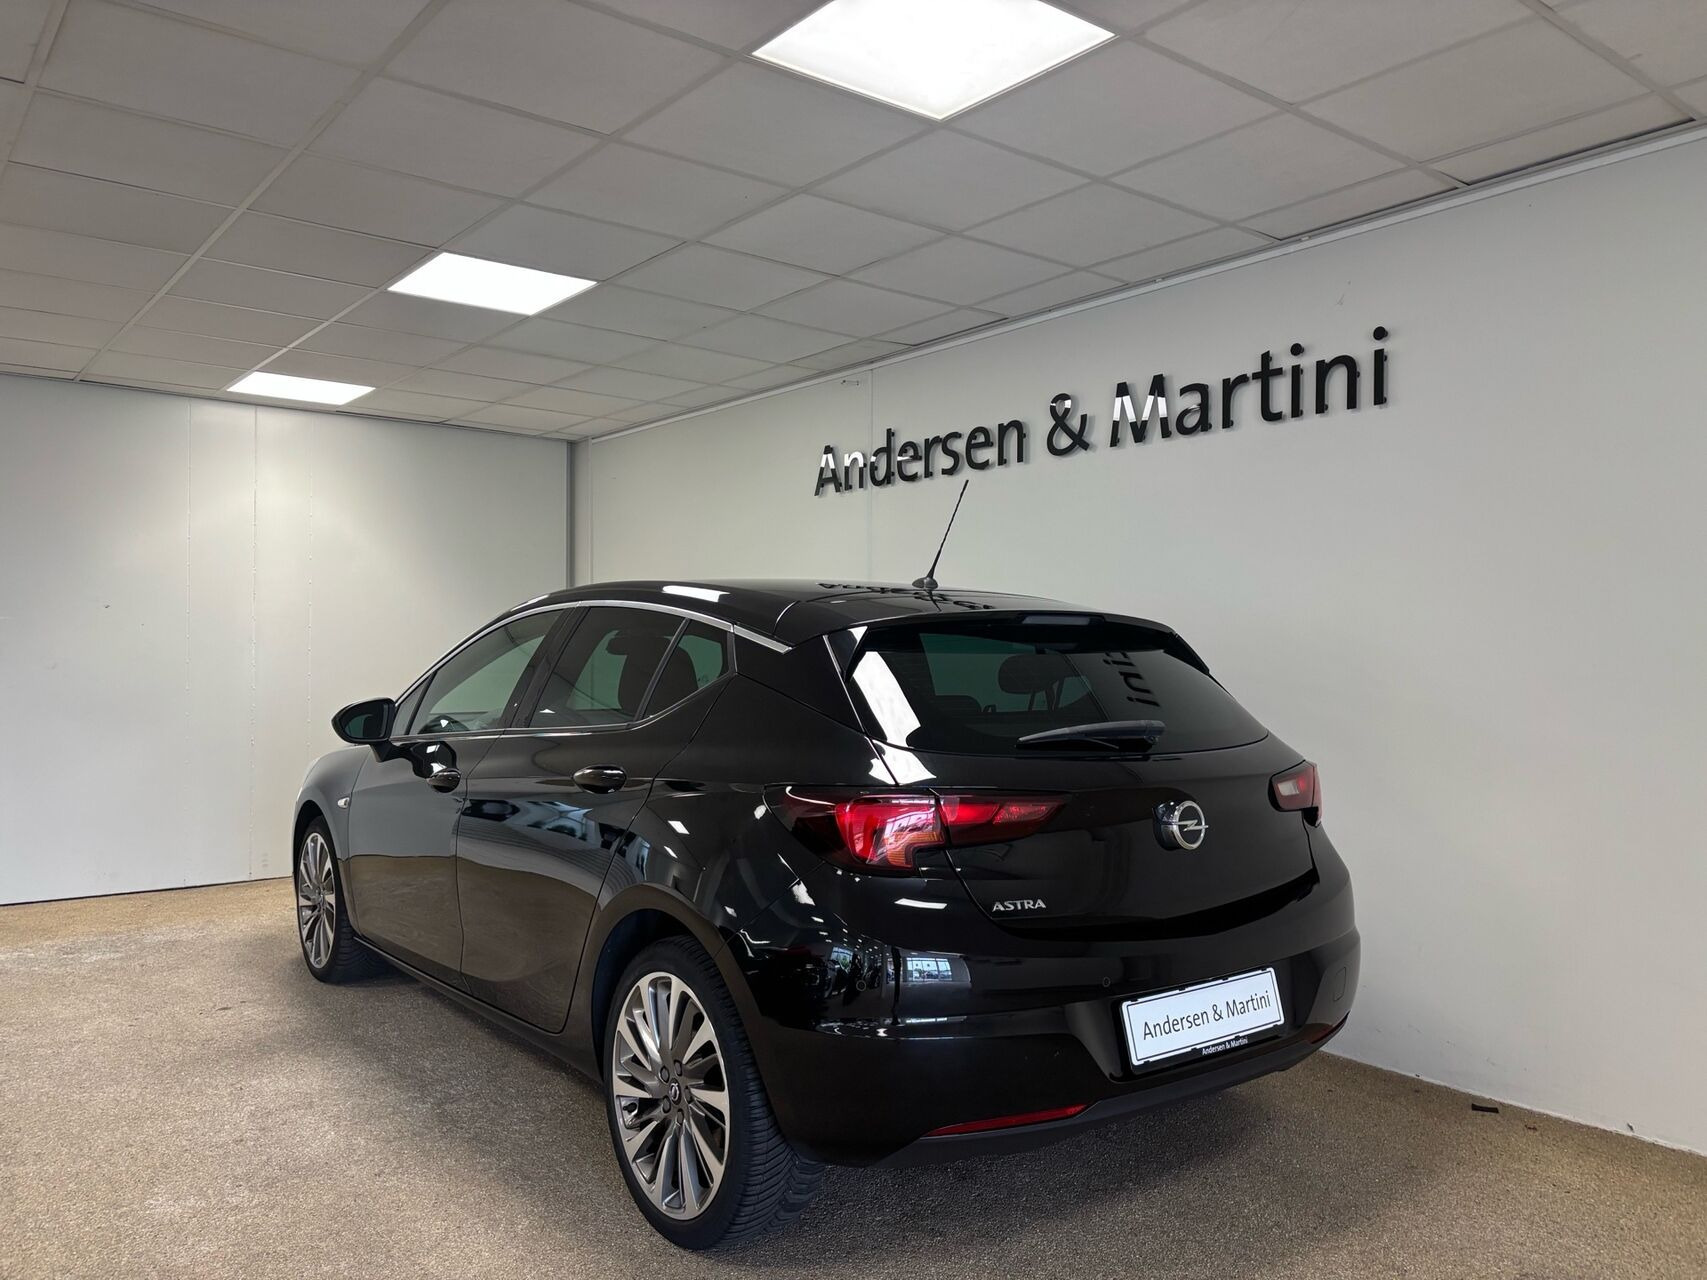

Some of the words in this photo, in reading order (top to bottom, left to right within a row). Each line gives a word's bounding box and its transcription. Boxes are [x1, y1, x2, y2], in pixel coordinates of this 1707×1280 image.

[814, 417, 1026, 497] Andersen
[1046, 392, 1090, 457] &
[1110, 325, 1389, 448] Martini
[992, 898, 1047, 912] ASTRA
[1143, 1009, 1210, 1041] Andersen
[1212, 1004, 1224, 1022] &
[1226, 990, 1271, 1019] Martini
[1201, 1043, 1226, 1056] Andersen
[1225, 1041, 1231, 1050] &
[1230, 1036, 1248, 1048] Martini
